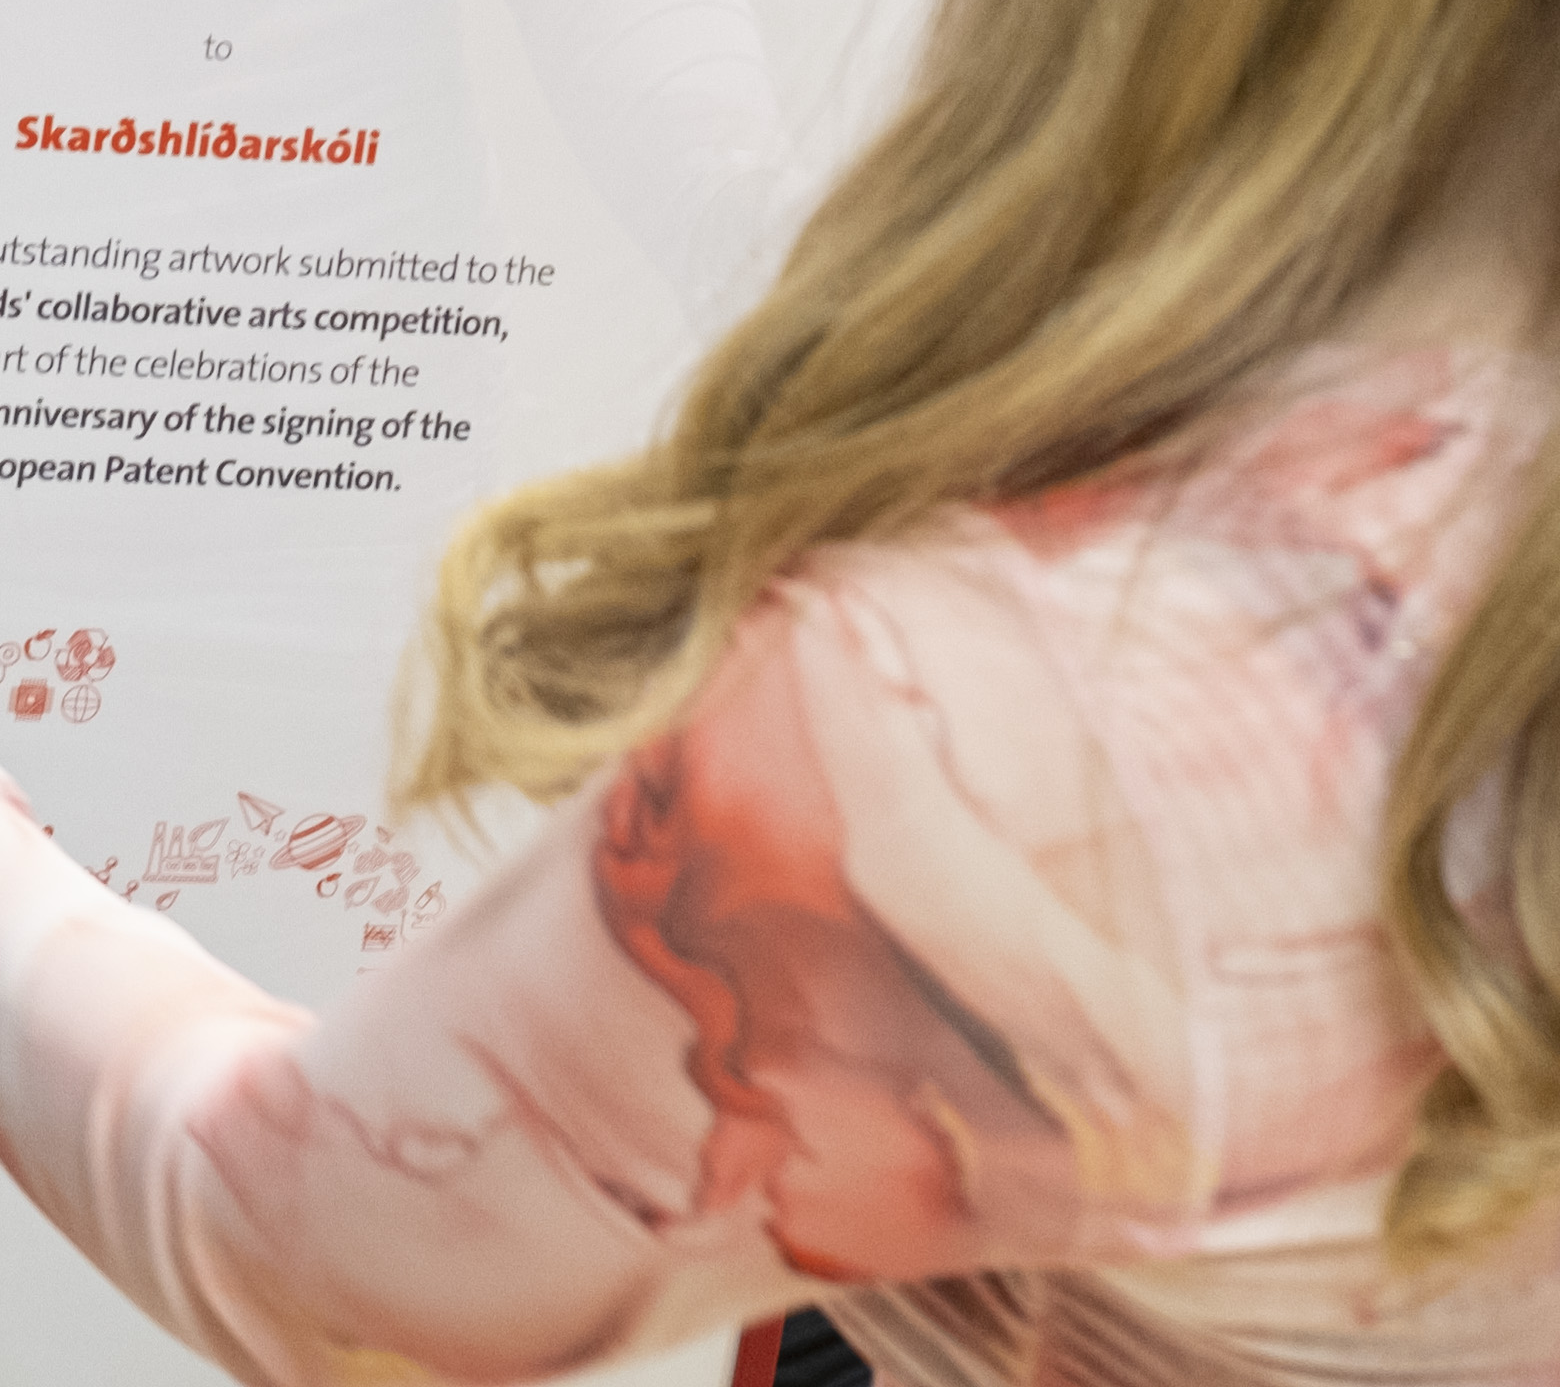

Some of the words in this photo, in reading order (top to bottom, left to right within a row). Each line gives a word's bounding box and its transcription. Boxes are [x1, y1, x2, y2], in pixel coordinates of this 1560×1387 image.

[202, 33, 234, 63] to
[15, 114, 382, 167] Skarðshlíðarskóli
[168, 243, 292, 275] artwork
[298, 247, 460, 284] submitted
[466, 255, 498, 285] to
[504, 255, 556, 287] the
[37, 291, 242, 327] collaborative
[248, 301, 308, 329] arts
[314, 305, 509, 343] competition,
[34, 343, 73, 375] of
[74, 345, 127, 378] the
[134, 348, 323, 385] celebrations
[330, 354, 368, 386] of
[369, 355, 421, 388] the
[163, 402, 202, 433] of
[203, 403, 256, 435] the
[262, 405, 376, 448] signing
[381, 409, 419, 439] of
[420, 409, 472, 442] the
[103, 455, 209, 487] Patent
[215, 458, 402, 493] Convention.
